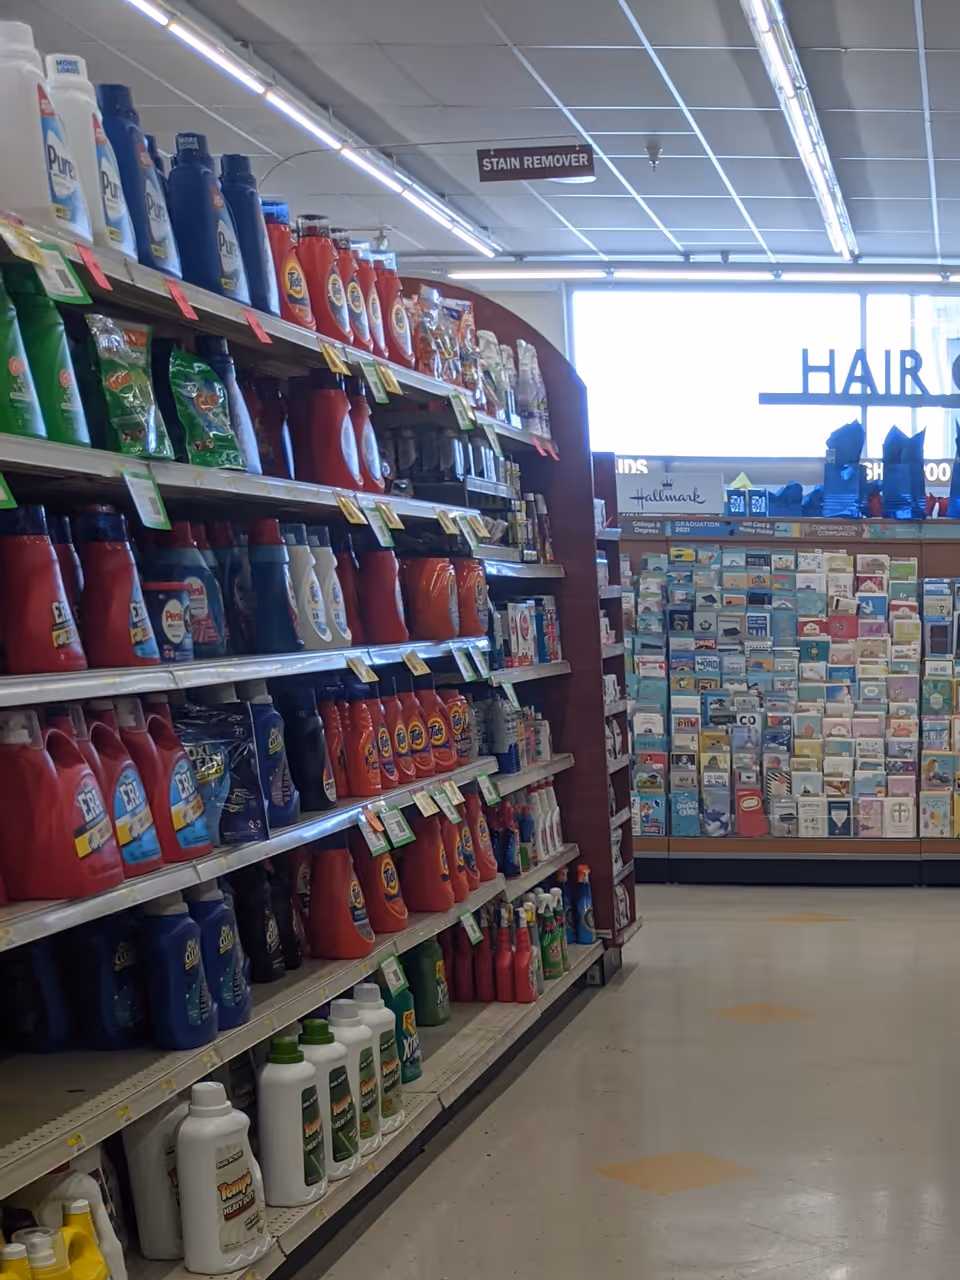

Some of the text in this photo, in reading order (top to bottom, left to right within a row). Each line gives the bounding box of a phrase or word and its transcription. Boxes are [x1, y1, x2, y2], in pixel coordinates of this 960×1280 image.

[56, 59, 78, 67] MORE
[47, 144, 74, 179] Pure
[482, 153, 588, 171] STAIN REMOVER
[287, 271, 303, 291] Tide
[802, 348, 928, 397] HAIR
[615, 459, 649, 474] IDS
[862, 461, 951, 482] SHOO
[629, 486, 707, 511] Hallmark
[811, 524, 858, 532] CONFIRMATION
[409, 728, 424, 743] Tide
[429, 724, 444, 739] Tide
[184, 744, 211, 762] OXI
[223, 1198, 244, 1216] HEAVY
